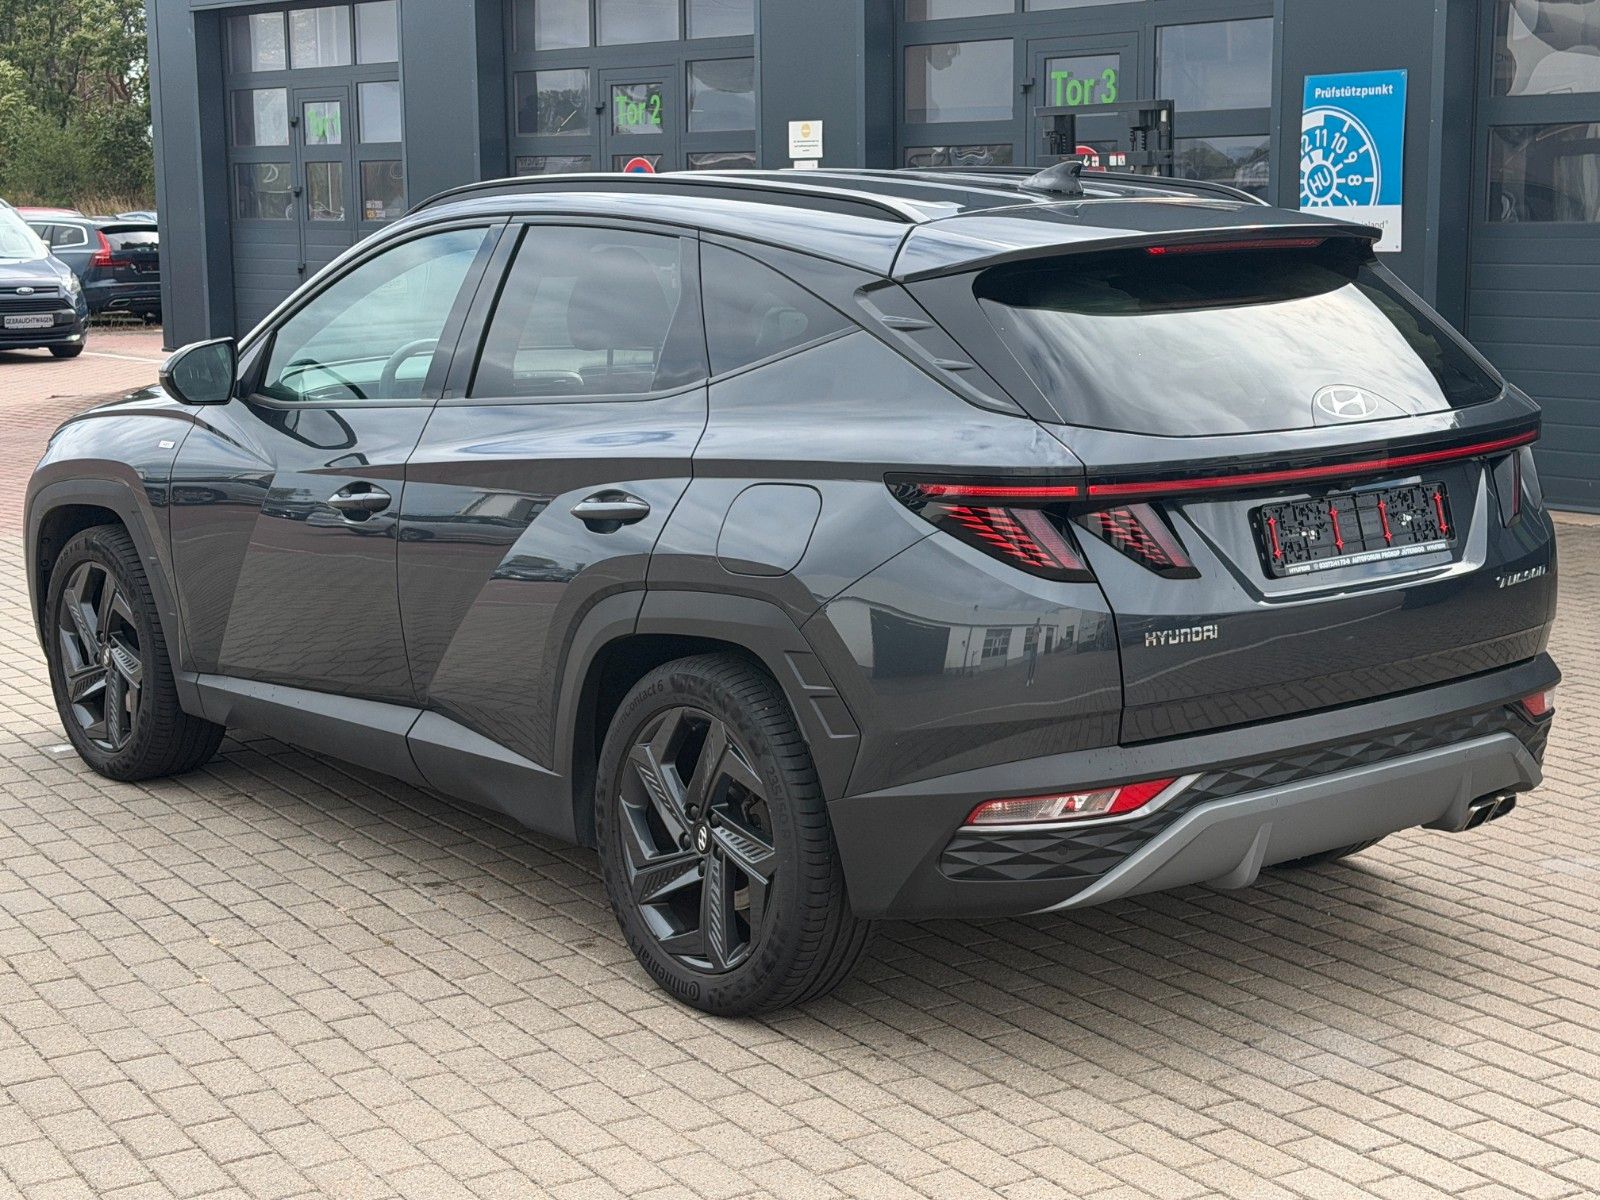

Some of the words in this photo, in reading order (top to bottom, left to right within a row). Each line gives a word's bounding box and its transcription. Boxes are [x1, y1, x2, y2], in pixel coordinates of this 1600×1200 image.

[1051, 70, 1096, 106] Tor
[1101, 68, 1117, 104] 3
[1314, 84, 1394, 99] Prüfstützpunkt
[616, 95, 646, 127] Tor
[650, 94, 661, 125] 2
[1300, 134, 1313, 156] 2
[1314, 128, 1328, 147] 11
[1331, 132, 1348, 154] 10
[1343, 151, 1358, 164] 9
[1308, 167, 1332, 195] HU
[1347, 174, 1362, 186] 8
[1145, 624, 1218, 647] HYUNDAI
